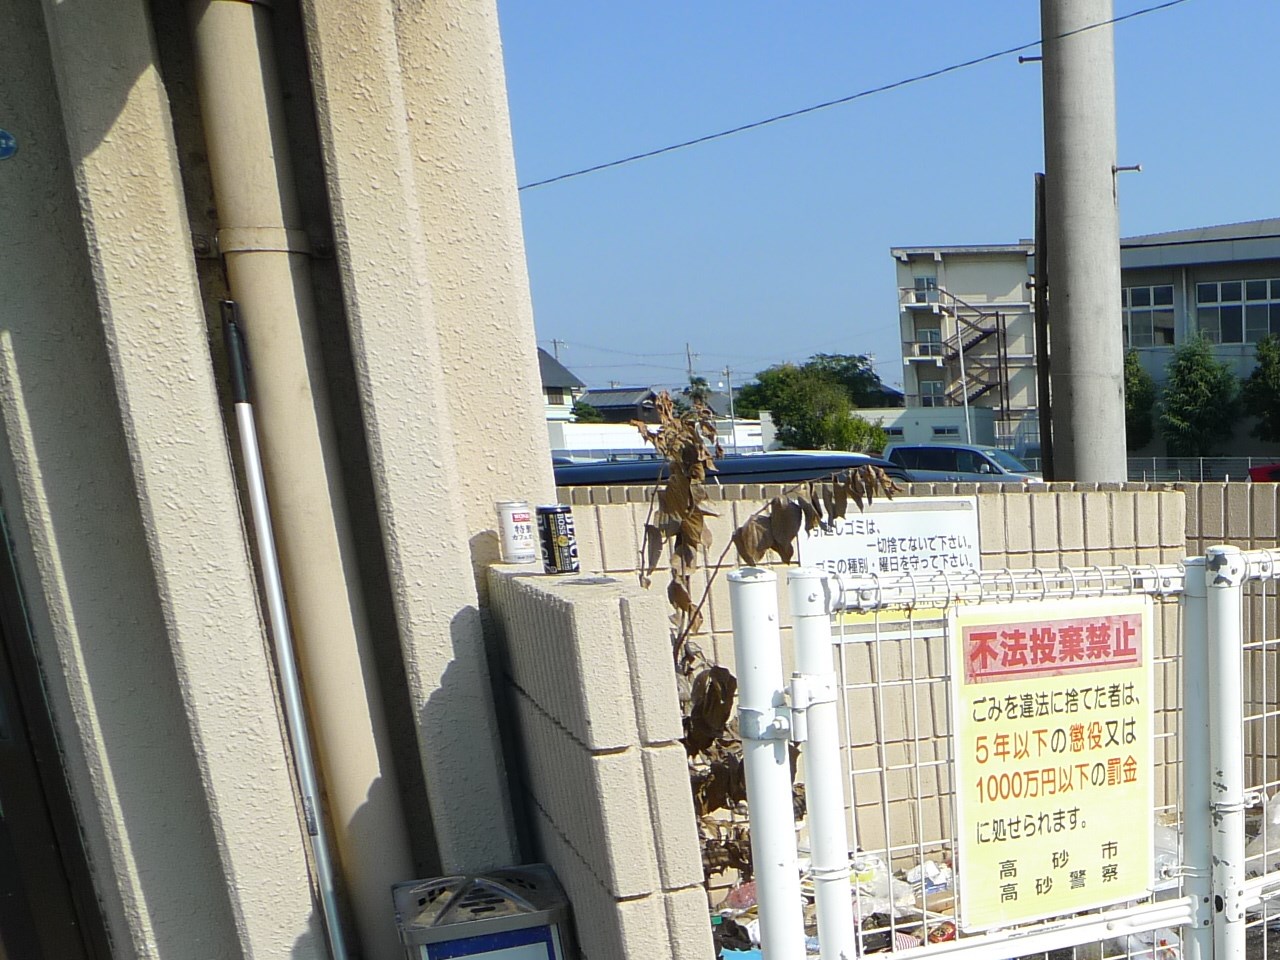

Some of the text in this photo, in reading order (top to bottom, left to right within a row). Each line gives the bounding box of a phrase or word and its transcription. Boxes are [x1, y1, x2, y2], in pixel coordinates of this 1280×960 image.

[867, 535, 972, 554] 一切捨てないで下さい。
[968, 621, 1138, 669] 不法投棄禁止
[972, 682, 1140, 722] ごみを違法に捨てた者は、
[975, 756, 1138, 804] 1000万円以下の罰金
[976, 806, 1088, 845] に処せられます。
